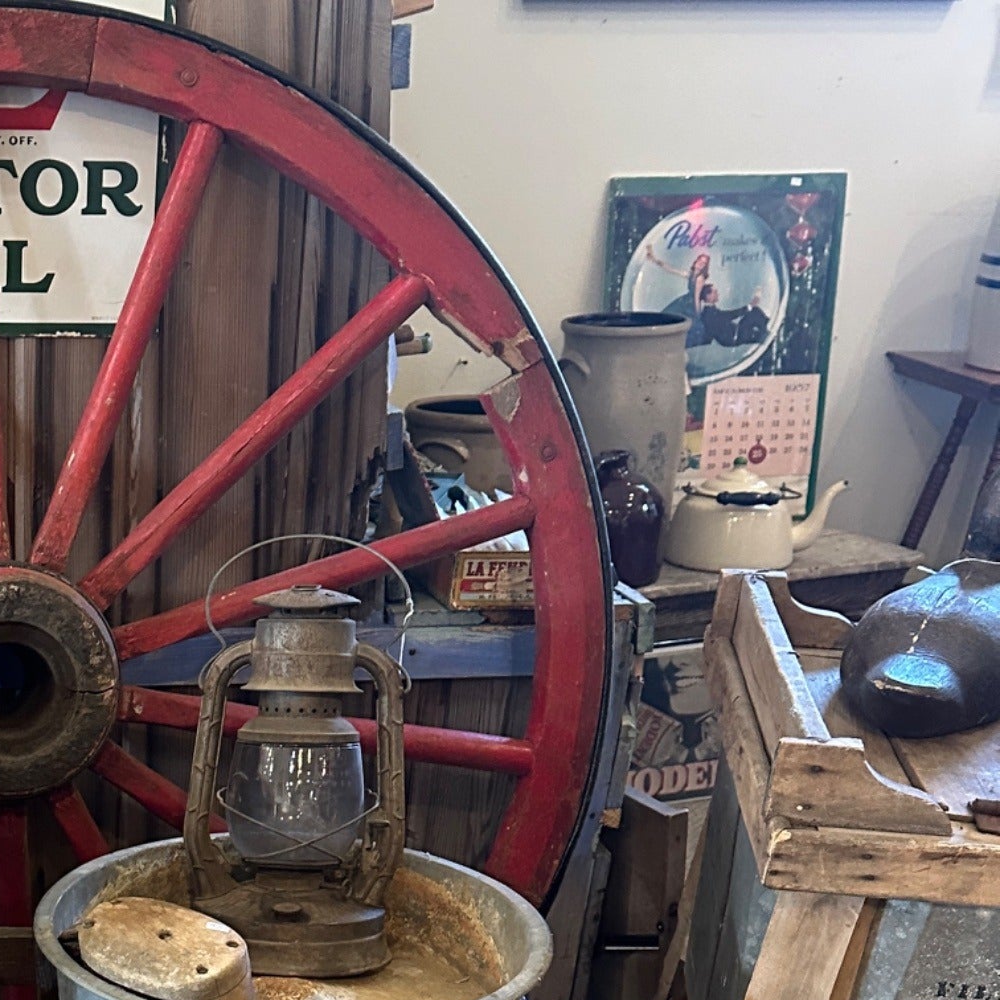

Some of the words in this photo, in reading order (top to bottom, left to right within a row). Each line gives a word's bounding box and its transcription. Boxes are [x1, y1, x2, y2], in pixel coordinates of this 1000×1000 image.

[9, 135, 37, 145] OFF.
[664, 220, 721, 250] Pabst
[466, 562, 485, 576] LA
